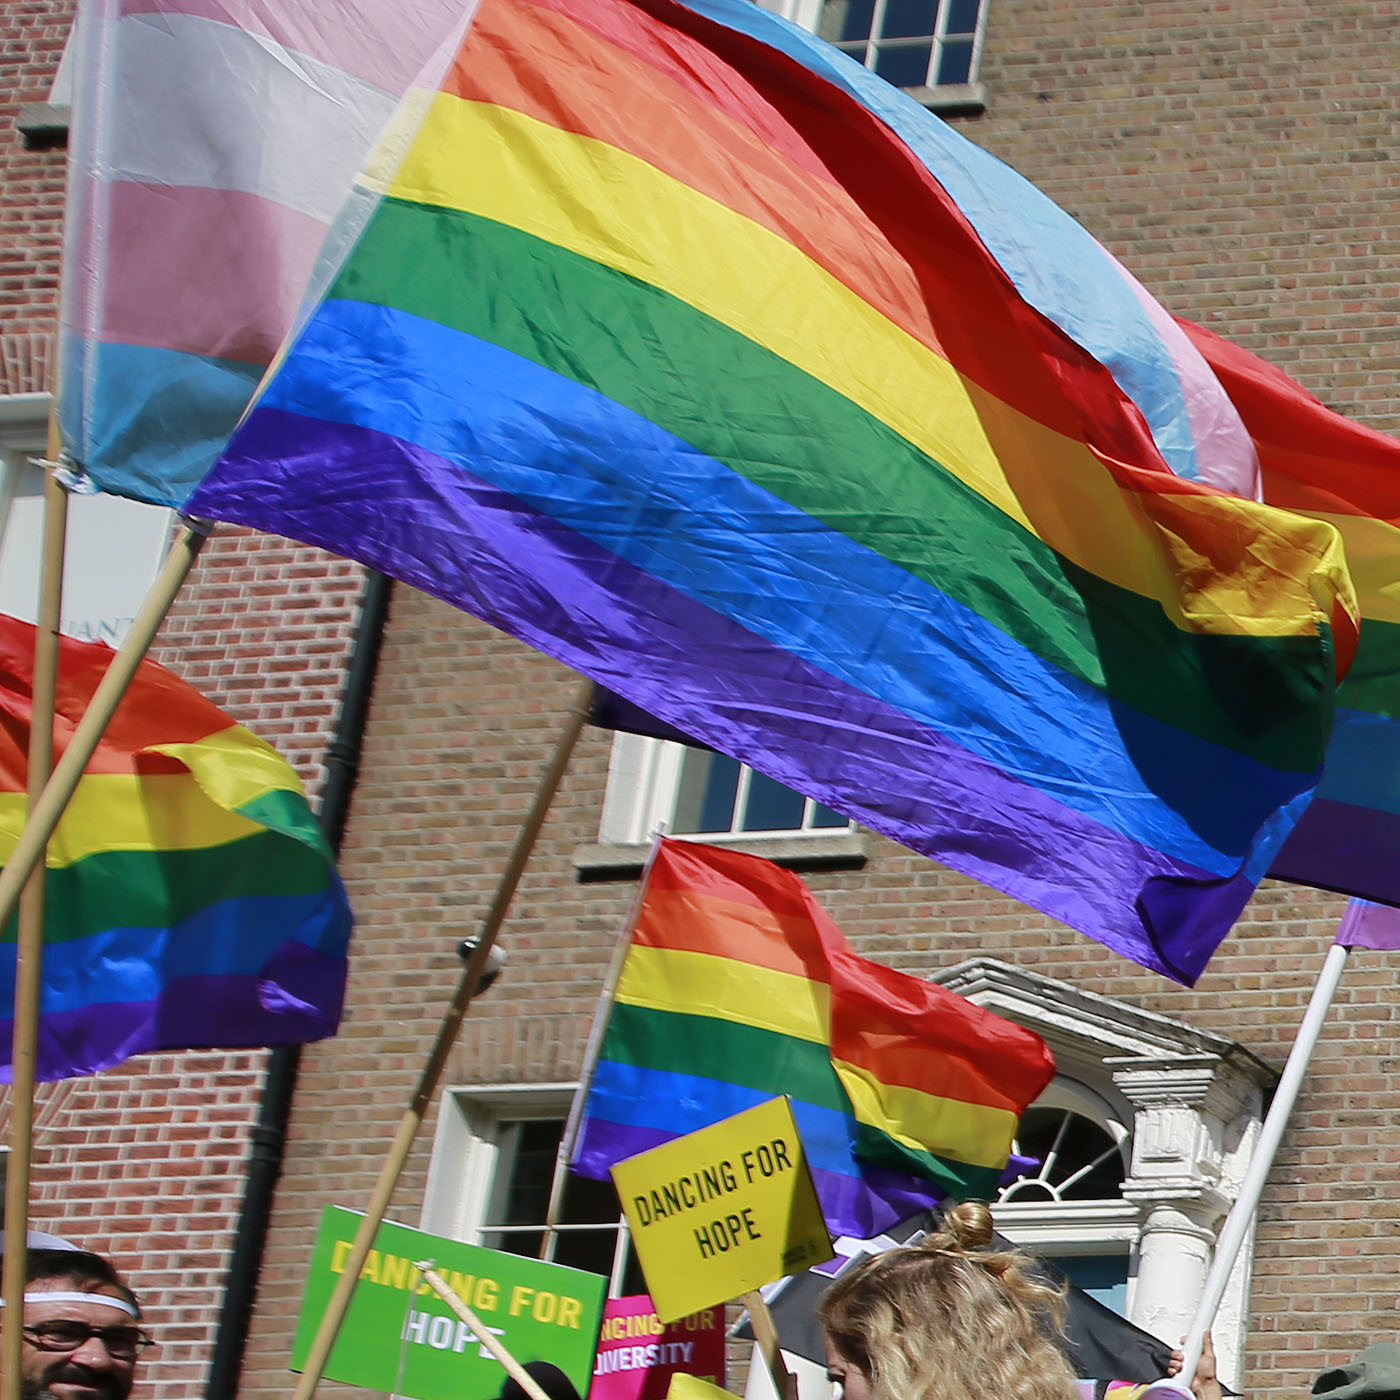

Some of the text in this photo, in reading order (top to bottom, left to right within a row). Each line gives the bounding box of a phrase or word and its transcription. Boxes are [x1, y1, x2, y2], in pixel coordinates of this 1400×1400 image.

[633, 1138, 792, 1227] DANCING FOR
[693, 1208, 761, 1259] HOPE
[508, 1284, 584, 1330] FOR
